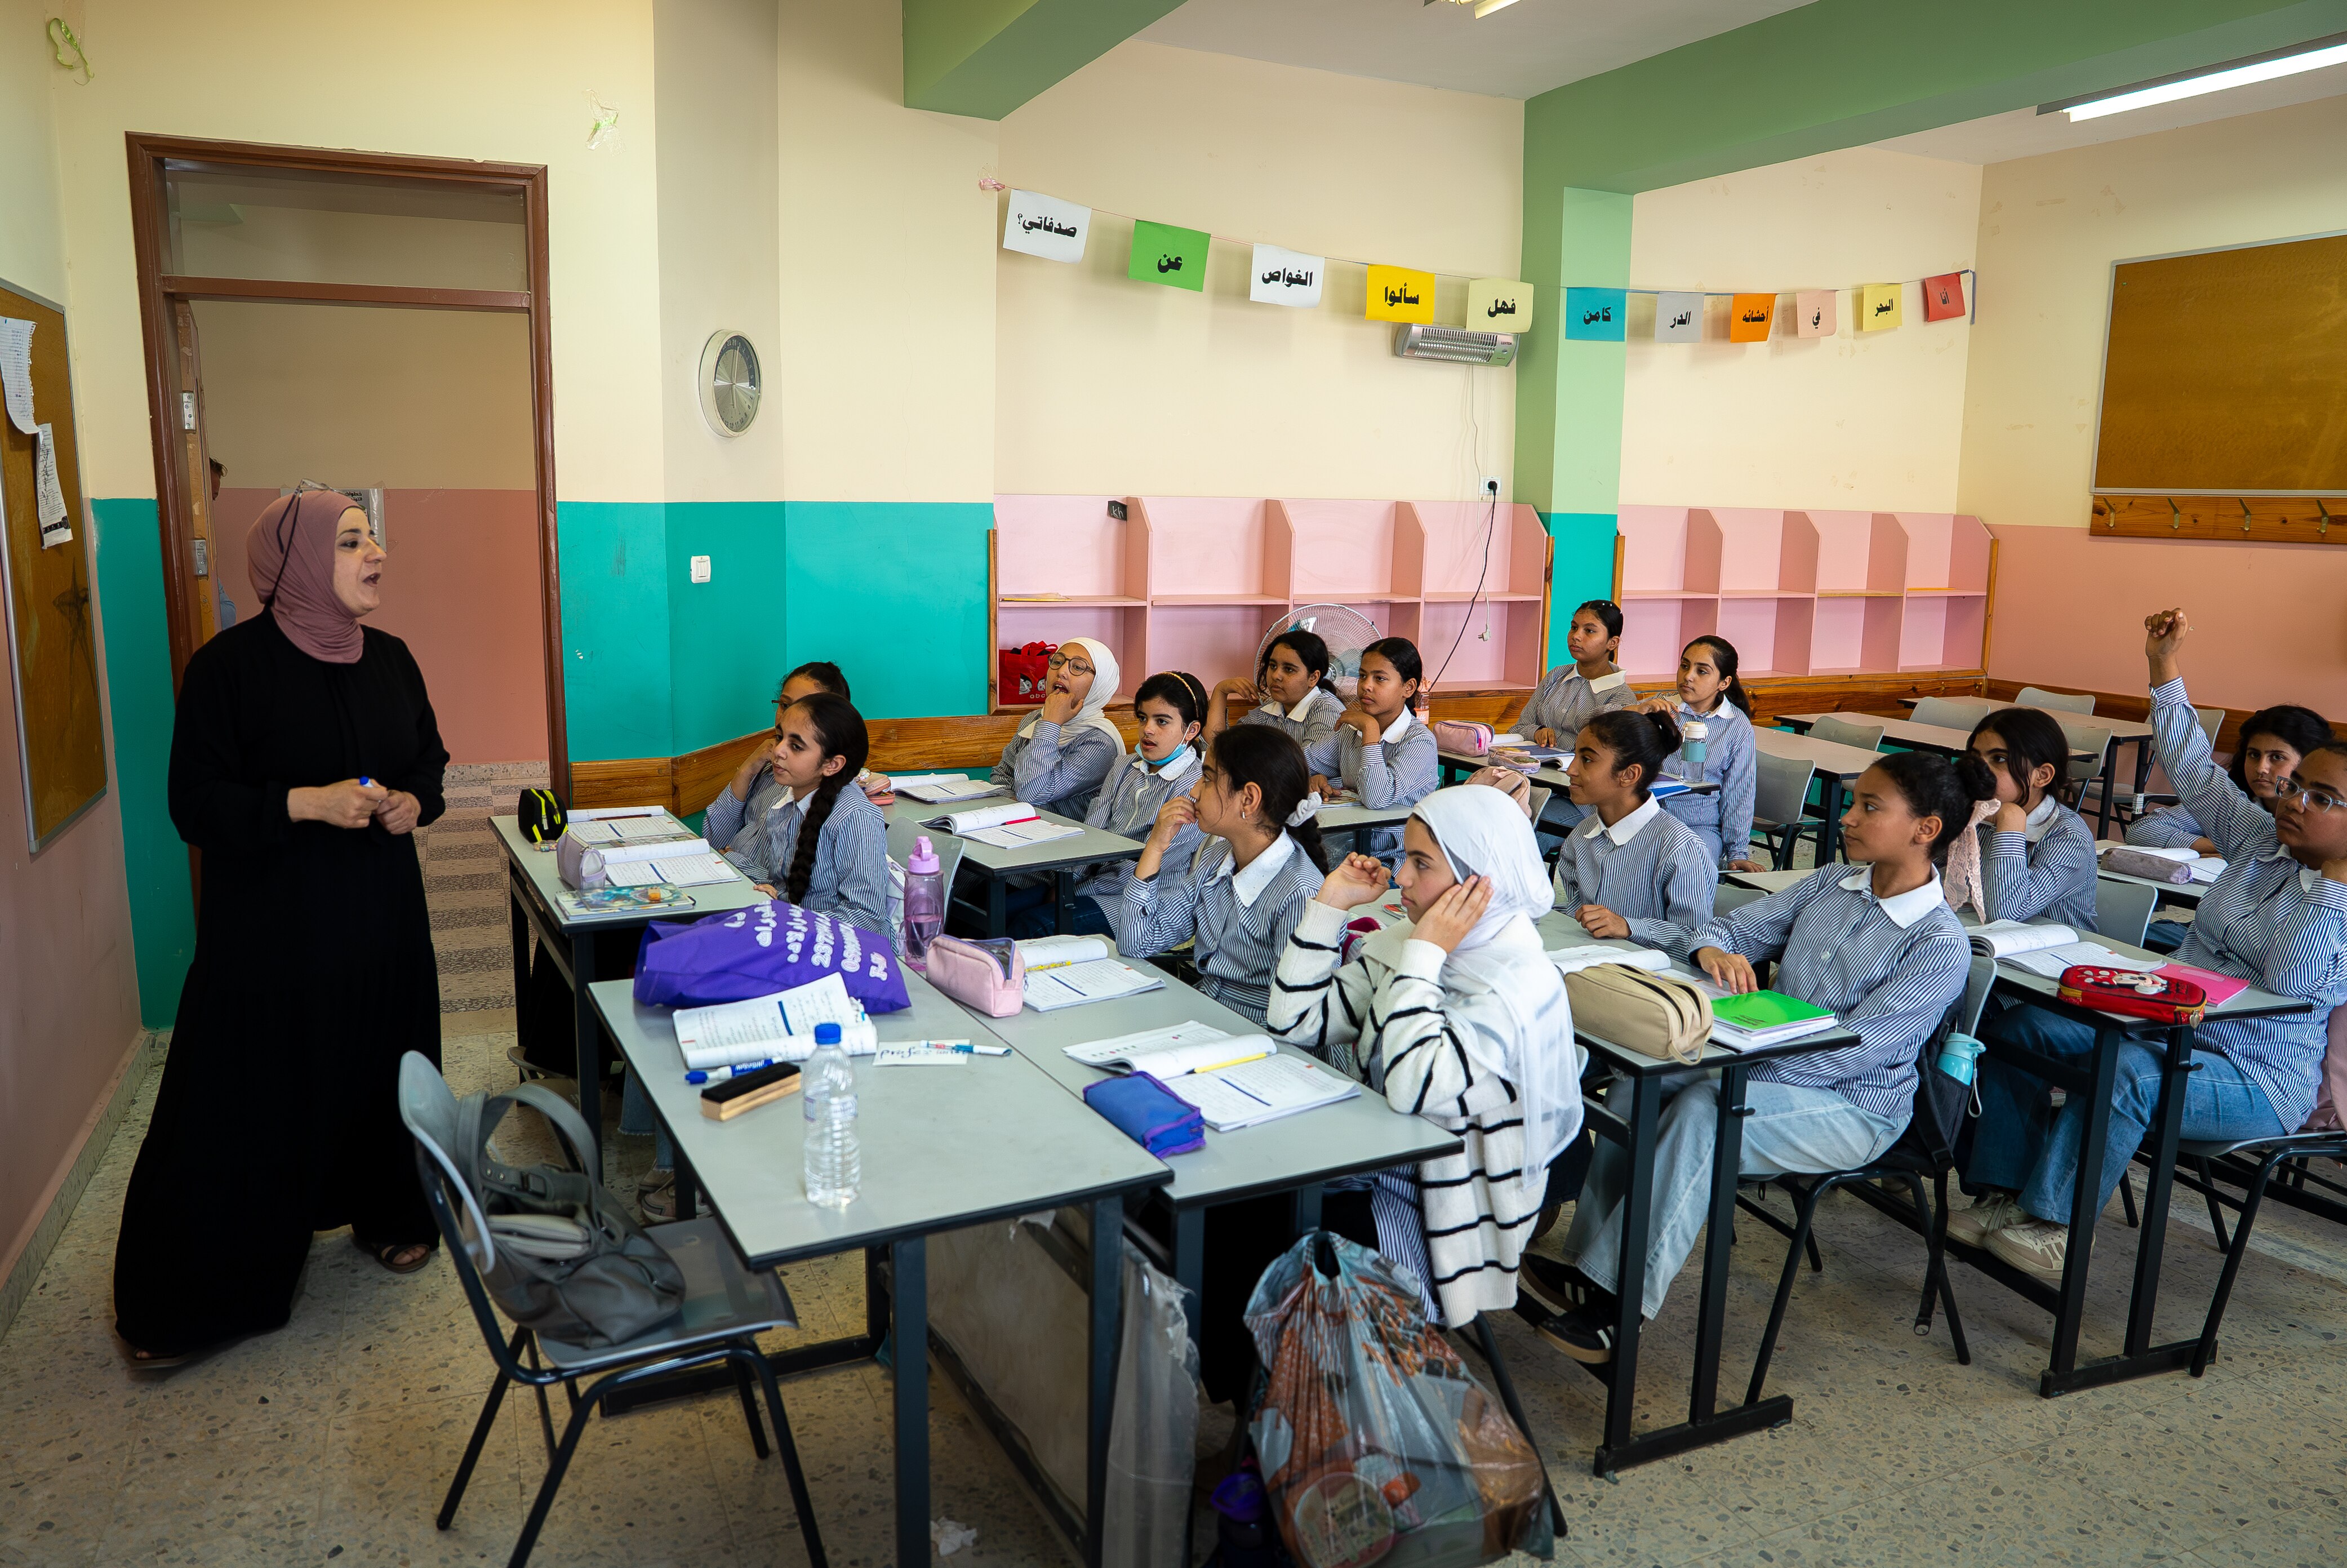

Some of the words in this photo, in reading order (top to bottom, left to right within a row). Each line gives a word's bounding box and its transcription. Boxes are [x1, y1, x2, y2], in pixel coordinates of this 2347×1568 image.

[1017, 212, 1077, 238] صدفاتي؟
[1157, 253, 1183, 273] عن
[1261, 267, 1313, 288] الغواص
[1385, 282, 1419, 305] سألوا
[1940, 287, 1950, 305] أنا
[1488, 299, 1516, 318] فهل
[1583, 307, 1611, 325] كامن
[1874, 298, 1893, 317] البحر
[1669, 310, 1691, 329] الدر
[1812, 307, 1821, 329] في
[1112, 505, 1124, 519] kh
